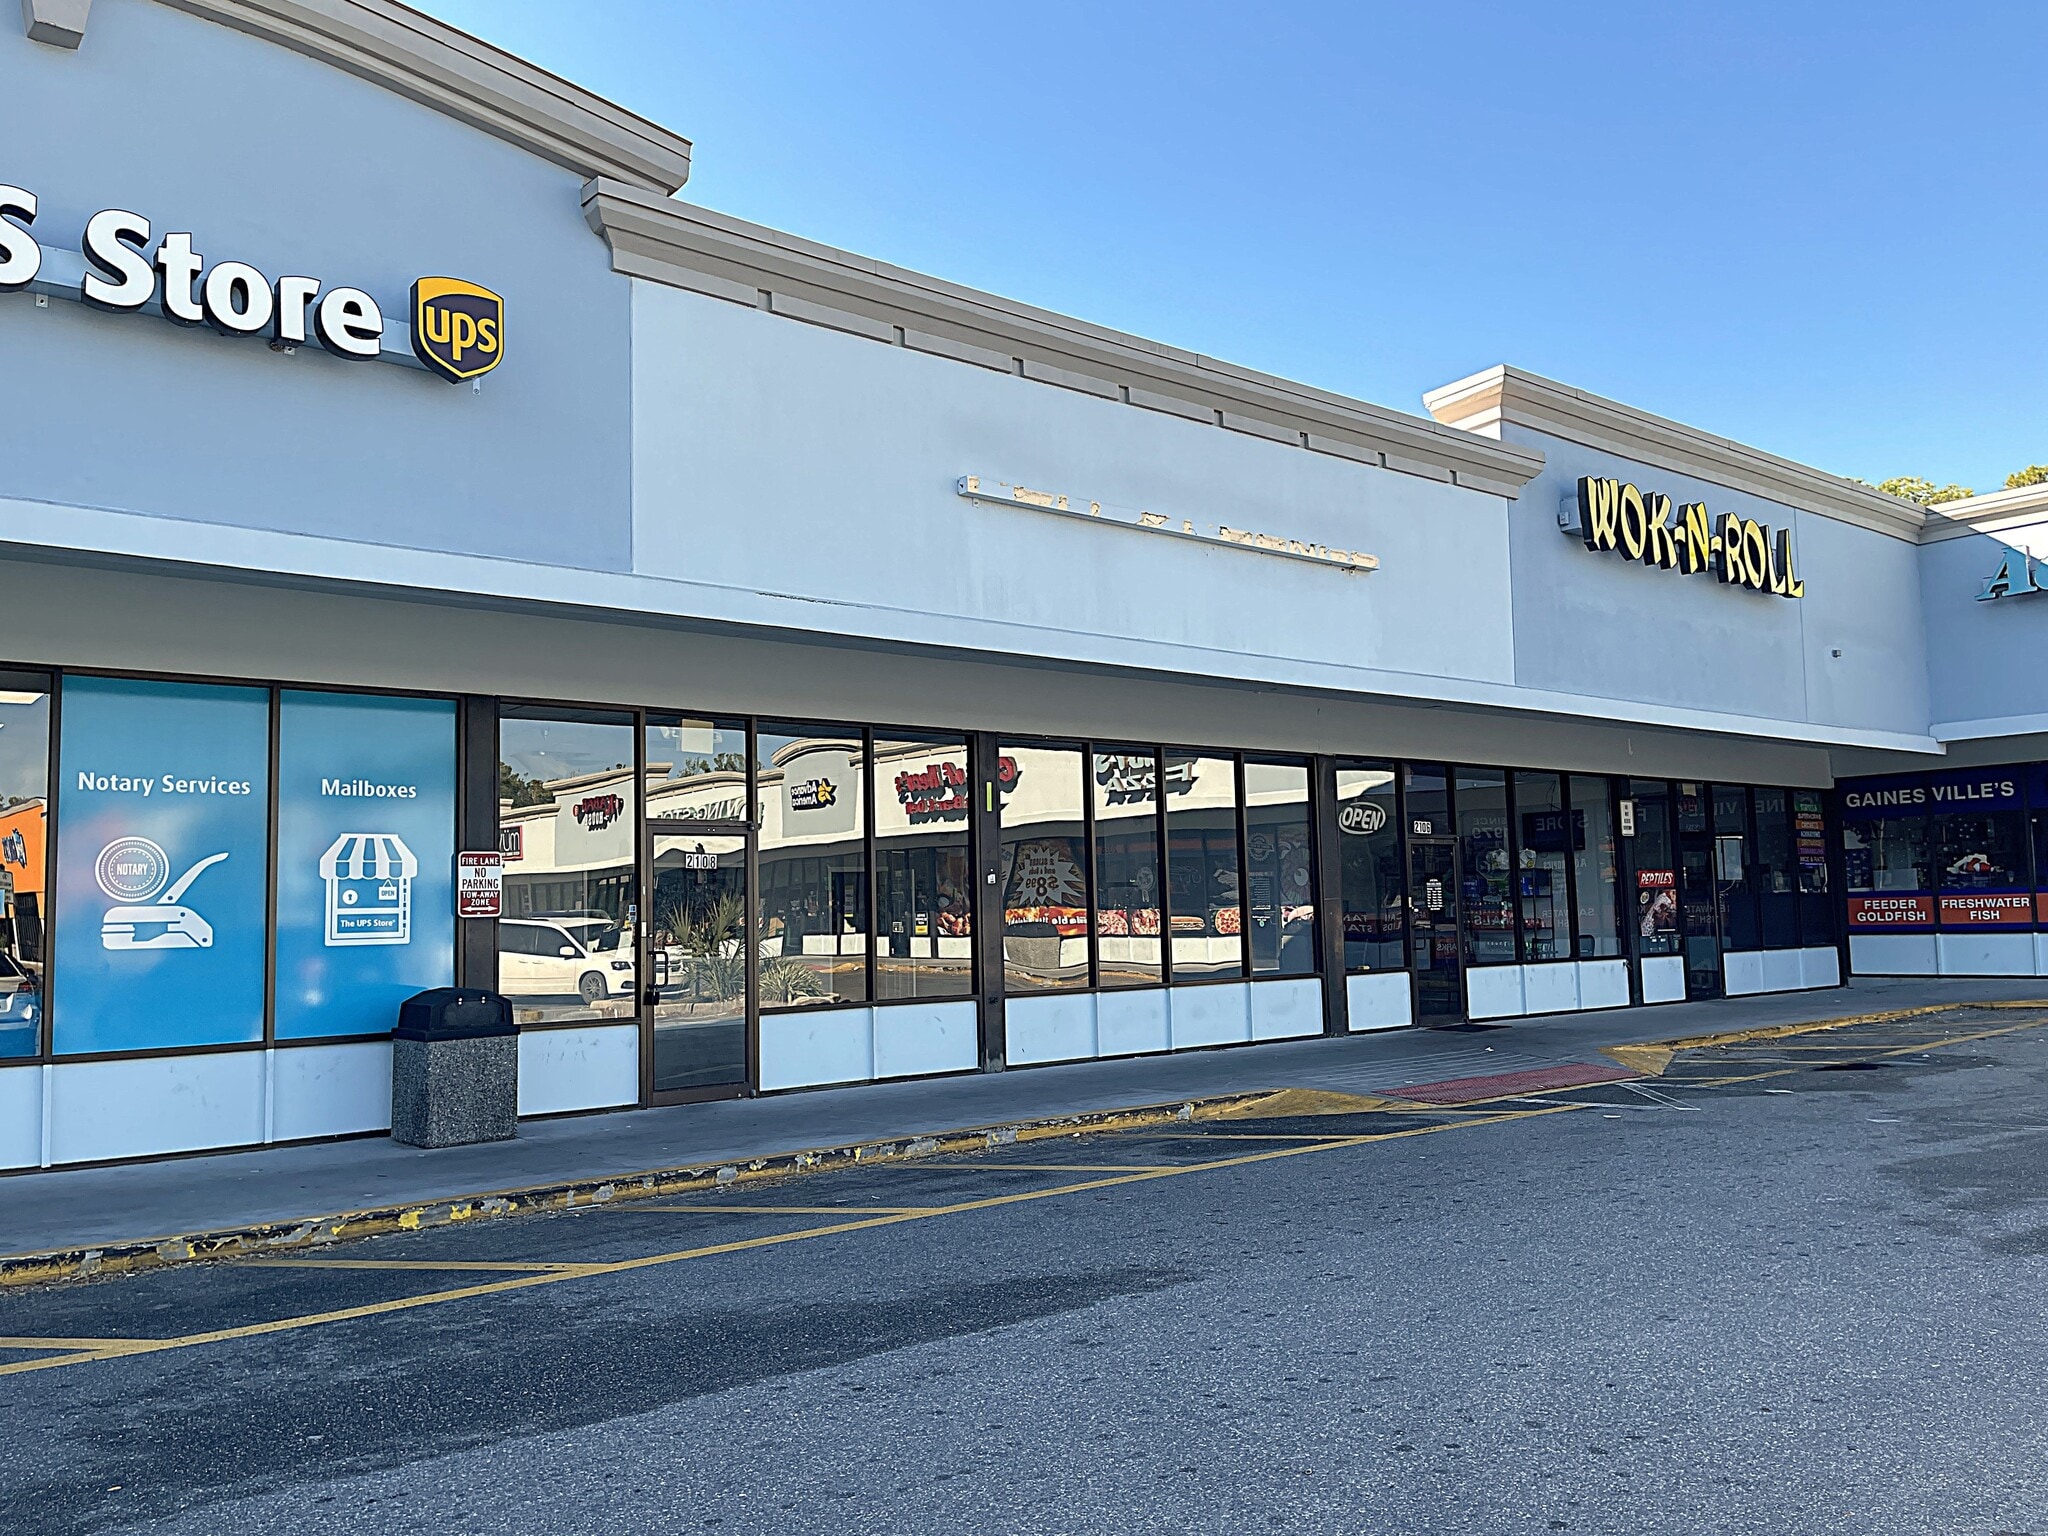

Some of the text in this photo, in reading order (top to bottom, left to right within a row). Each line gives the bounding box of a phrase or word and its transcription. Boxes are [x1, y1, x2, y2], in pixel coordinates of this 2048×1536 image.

[83, 208, 385, 357] Store
[425, 305, 499, 361] ups
[1577, 475, 1805, 599] WOK-N-ROLL
[78, 772, 251, 797] Notary Services
[321, 778, 417, 798] Mailboxes
[1846, 781, 2015, 807] GAINES VILLE'S
[1341, 807, 1381, 831] OPEN
[1413, 821, 1432, 834] 2106
[462, 857, 499, 865] FIRE LANE
[686, 854, 718, 869] 2108
[116, 863, 149, 877] NOTARY
[474, 867, 487, 878] NO
[462, 878, 499, 889] PARKING
[1640, 872, 1673, 885] REPTILES
[381, 889, 396, 897] OPEN
[462, 891, 499, 899] TOW-AWAY
[471, 898, 490, 906] ZONE
[1864, 899, 1918, 910] FEEDER
[1941, 897, 2031, 909] FRESHWATER
[1857, 911, 1927, 922] GOLDFISH
[1970, 910, 2001, 920] FISH
[341, 920, 355, 928] The
[357, 919, 372, 927] UPS
